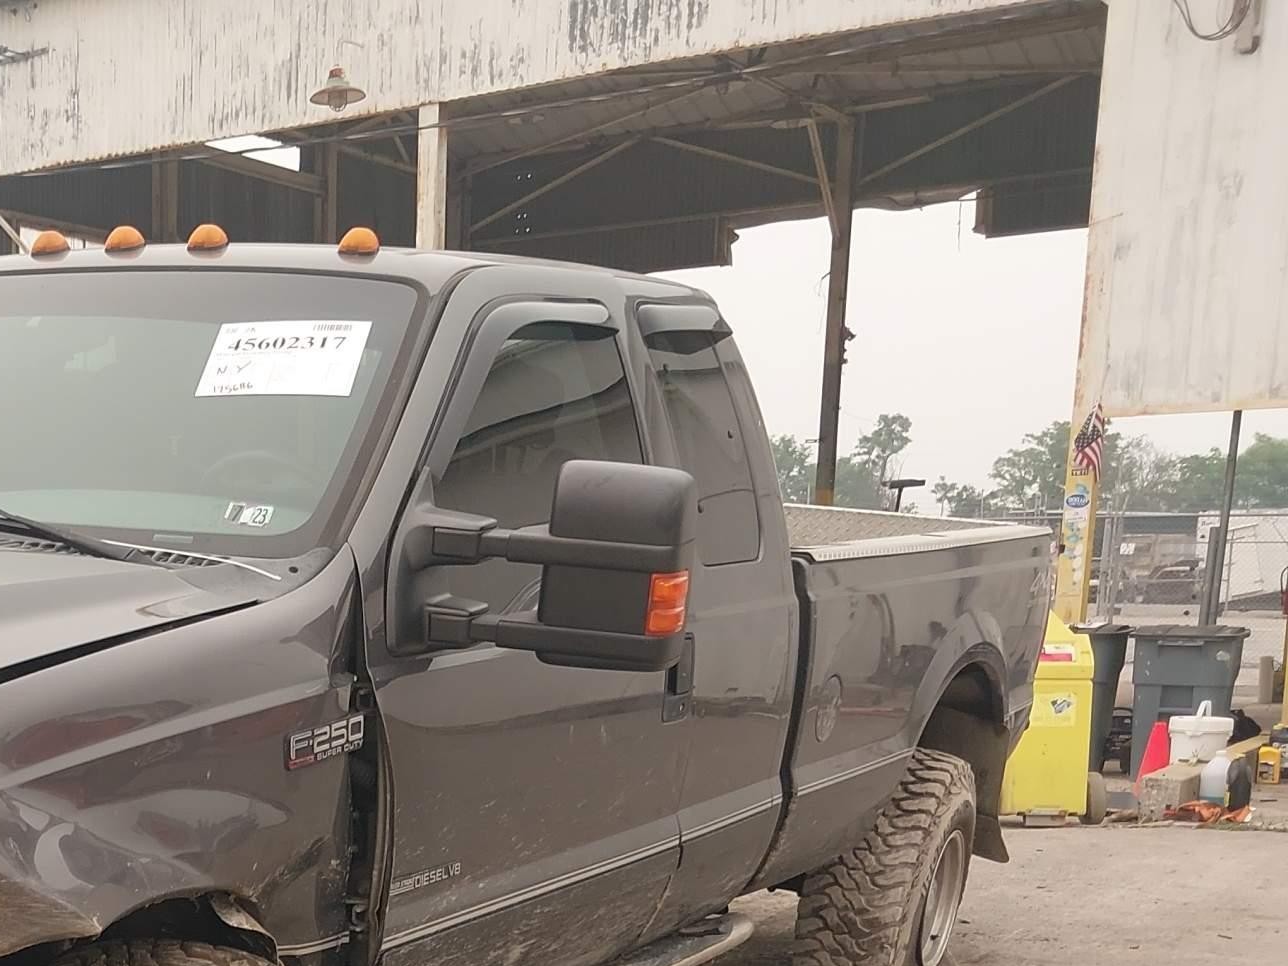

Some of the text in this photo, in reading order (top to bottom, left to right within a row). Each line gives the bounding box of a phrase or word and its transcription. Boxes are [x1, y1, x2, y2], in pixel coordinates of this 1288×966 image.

[227, 336, 347, 352] 45602317
[252, 507, 269, 525] 23
[316, 747, 342, 761] SUPER
[414, 865, 449, 889] DIESEL
[448, 862, 461, 878] V8
